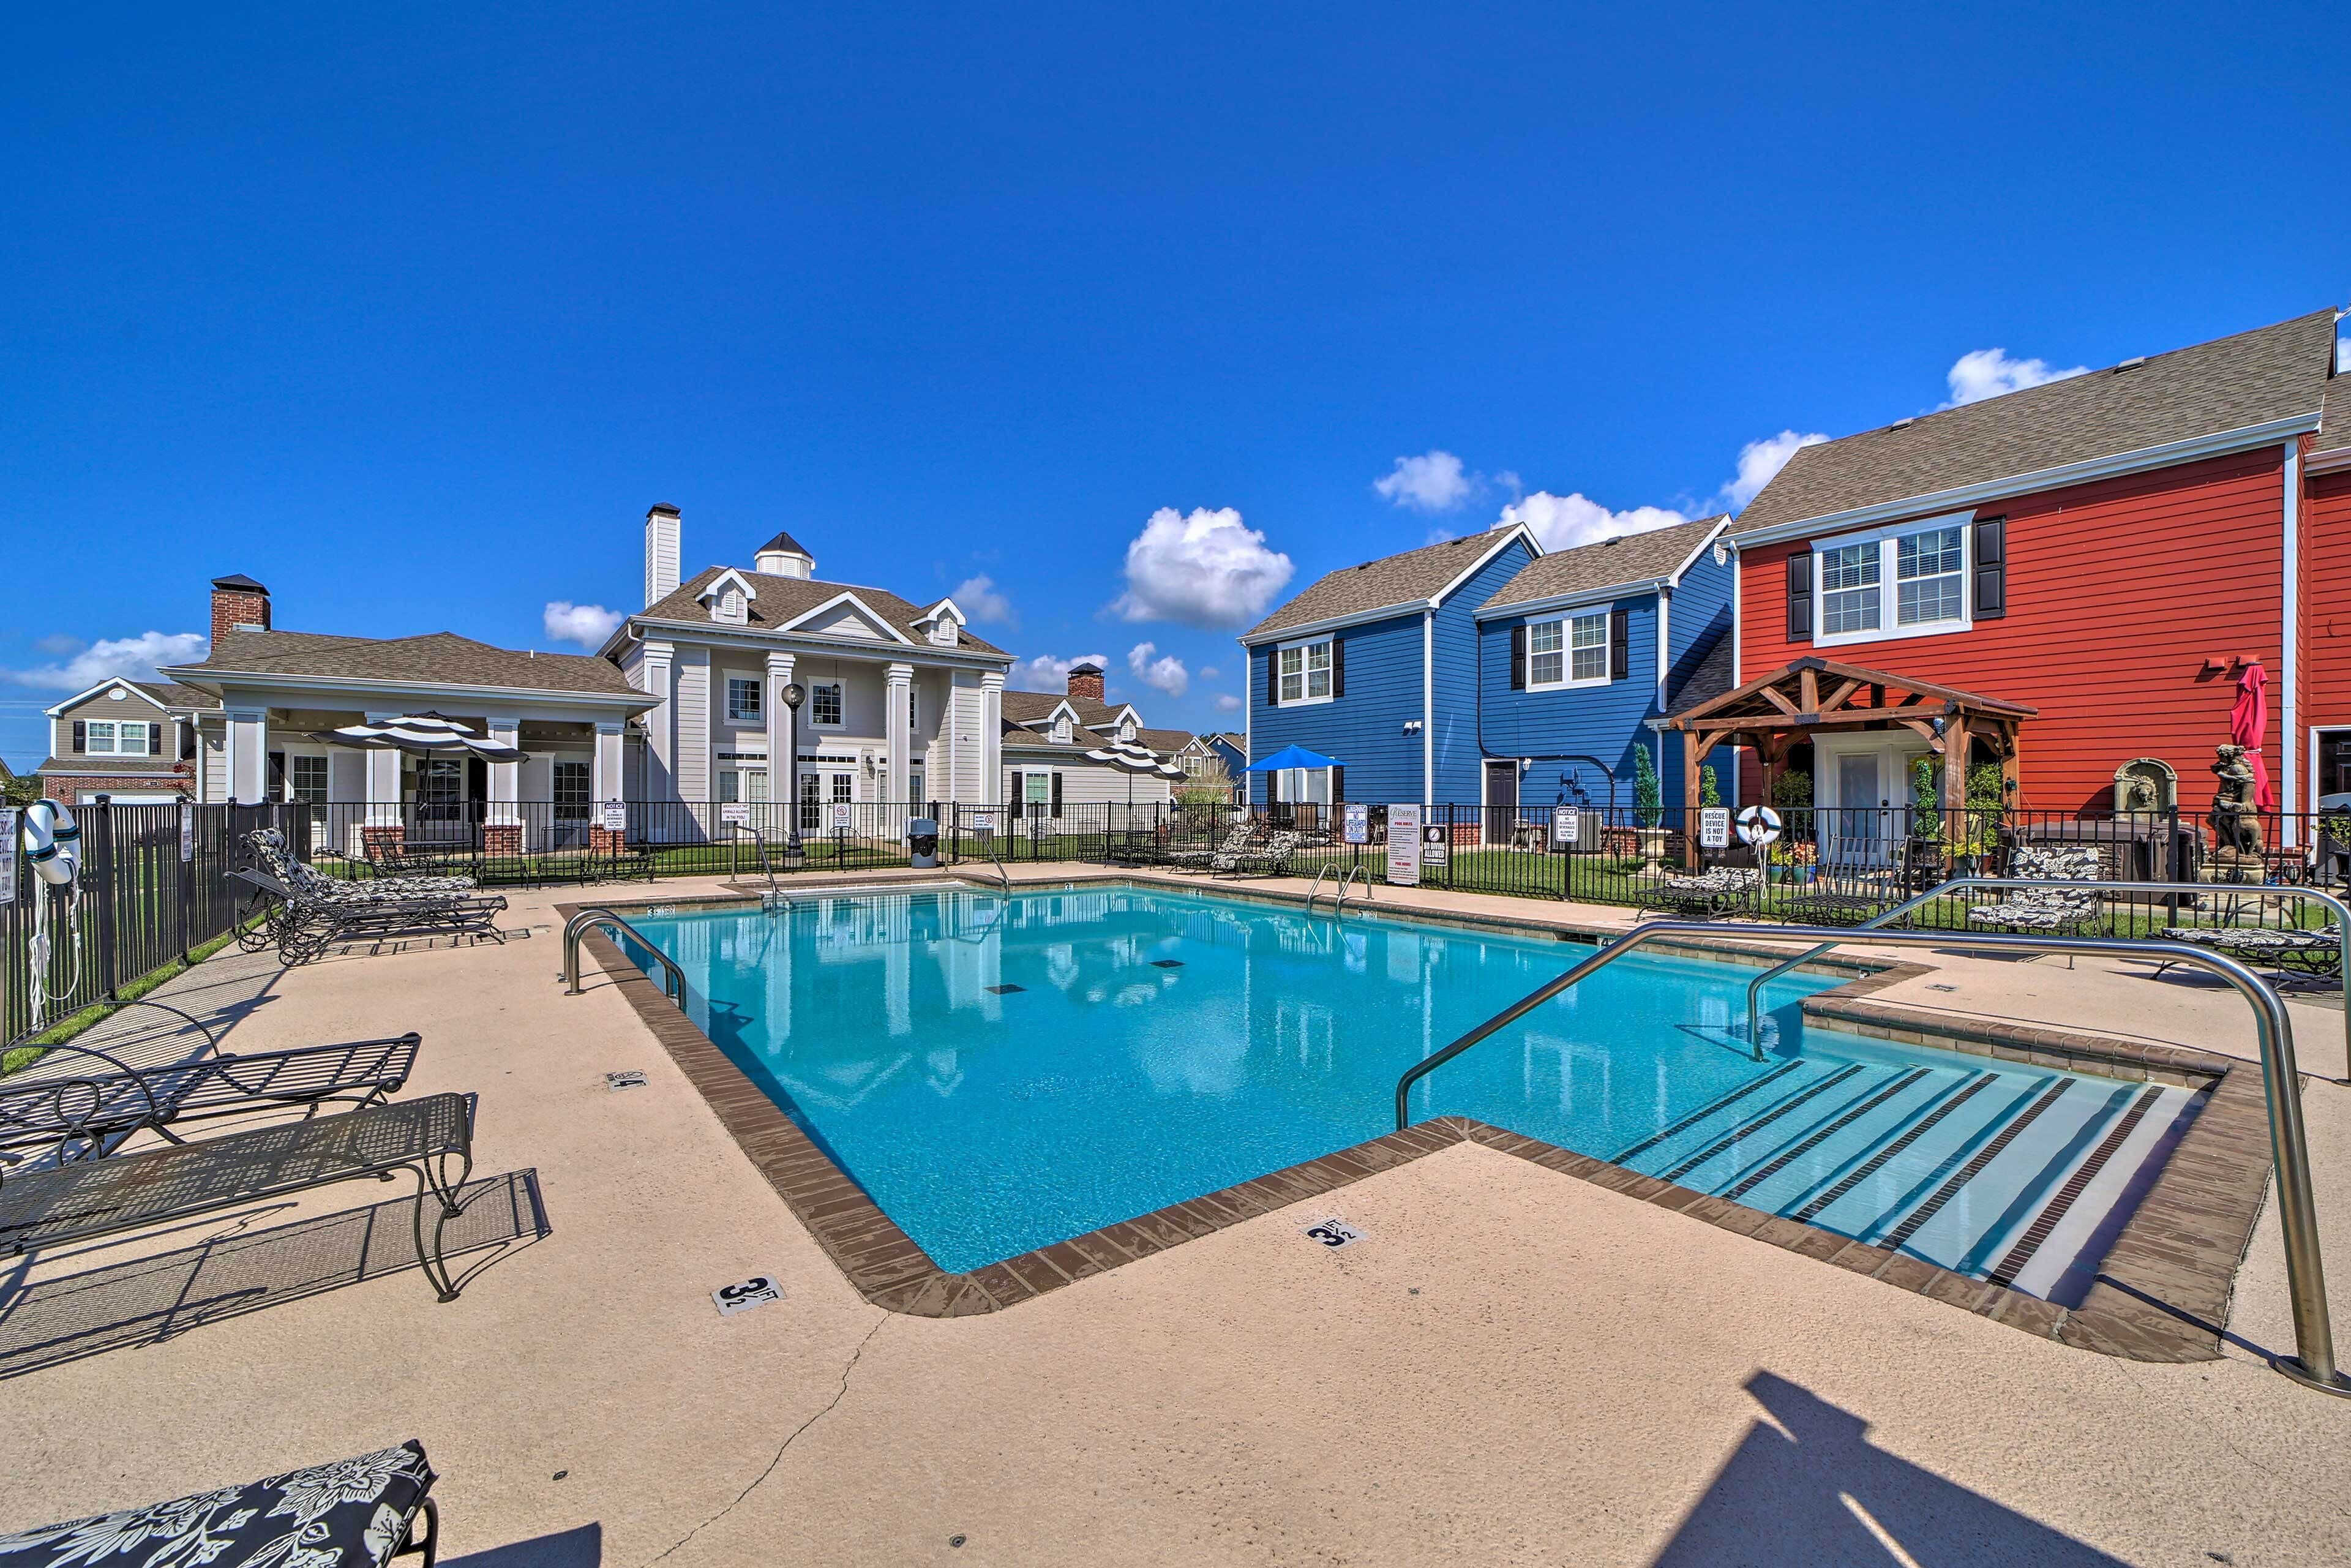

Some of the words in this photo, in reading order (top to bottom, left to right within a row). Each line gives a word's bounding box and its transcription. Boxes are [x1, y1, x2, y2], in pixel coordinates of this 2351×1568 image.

[1430, 842, 1445, 850] DIVING
[2, 857, 11, 872] NOT
[2, 876, 10, 891] TOY
